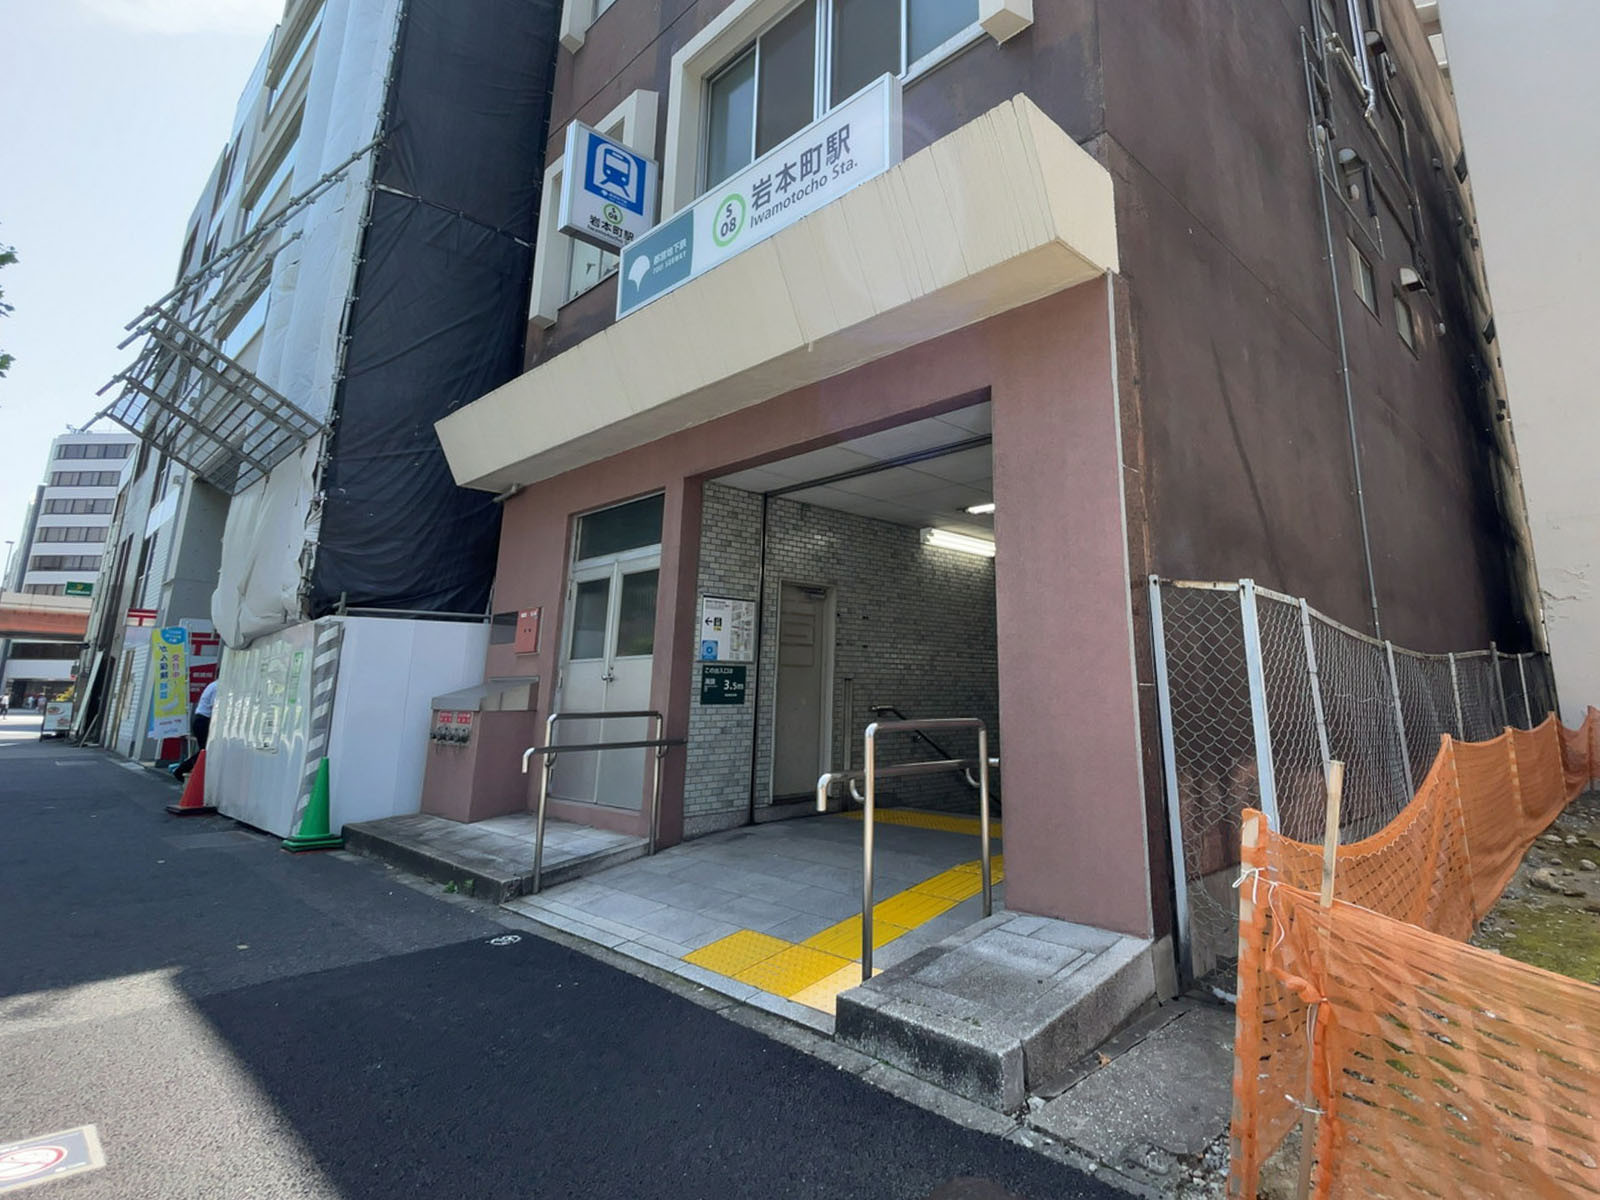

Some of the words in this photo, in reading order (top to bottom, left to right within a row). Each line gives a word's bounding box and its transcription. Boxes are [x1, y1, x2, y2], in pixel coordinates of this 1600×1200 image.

[750, 123, 850, 212] 岩本町駅
[750, 175, 828, 229] Iwamotocho
[832, 158, 858, 180] Sta.
[725, 203, 733, 219] S
[590, 214, 634, 242] 岩本町駅
[720, 217, 737, 237] 08
